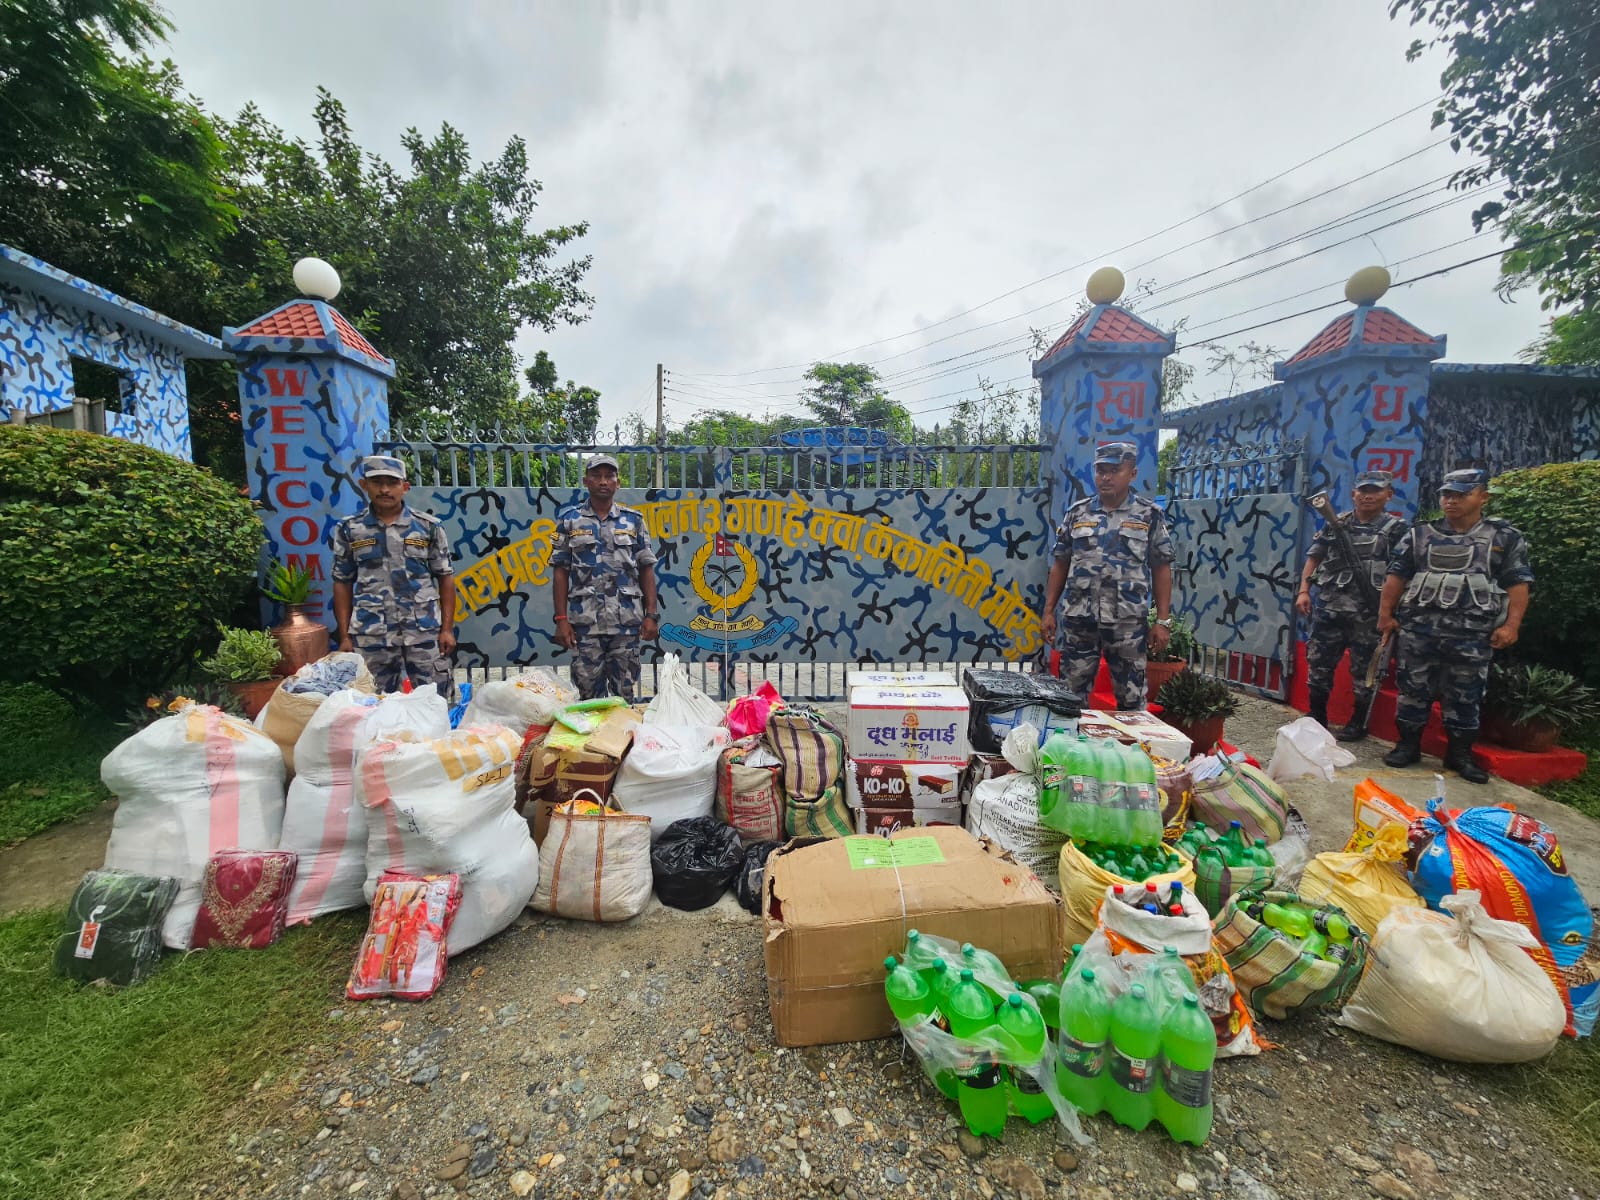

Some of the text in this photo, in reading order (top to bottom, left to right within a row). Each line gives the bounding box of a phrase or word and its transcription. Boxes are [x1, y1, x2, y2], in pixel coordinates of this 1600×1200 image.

[867, 723, 958, 747] दूध मलाई
[863, 777, 905, 795] KO-KO
[1499, 870, 1529, 917] DIAMOND
